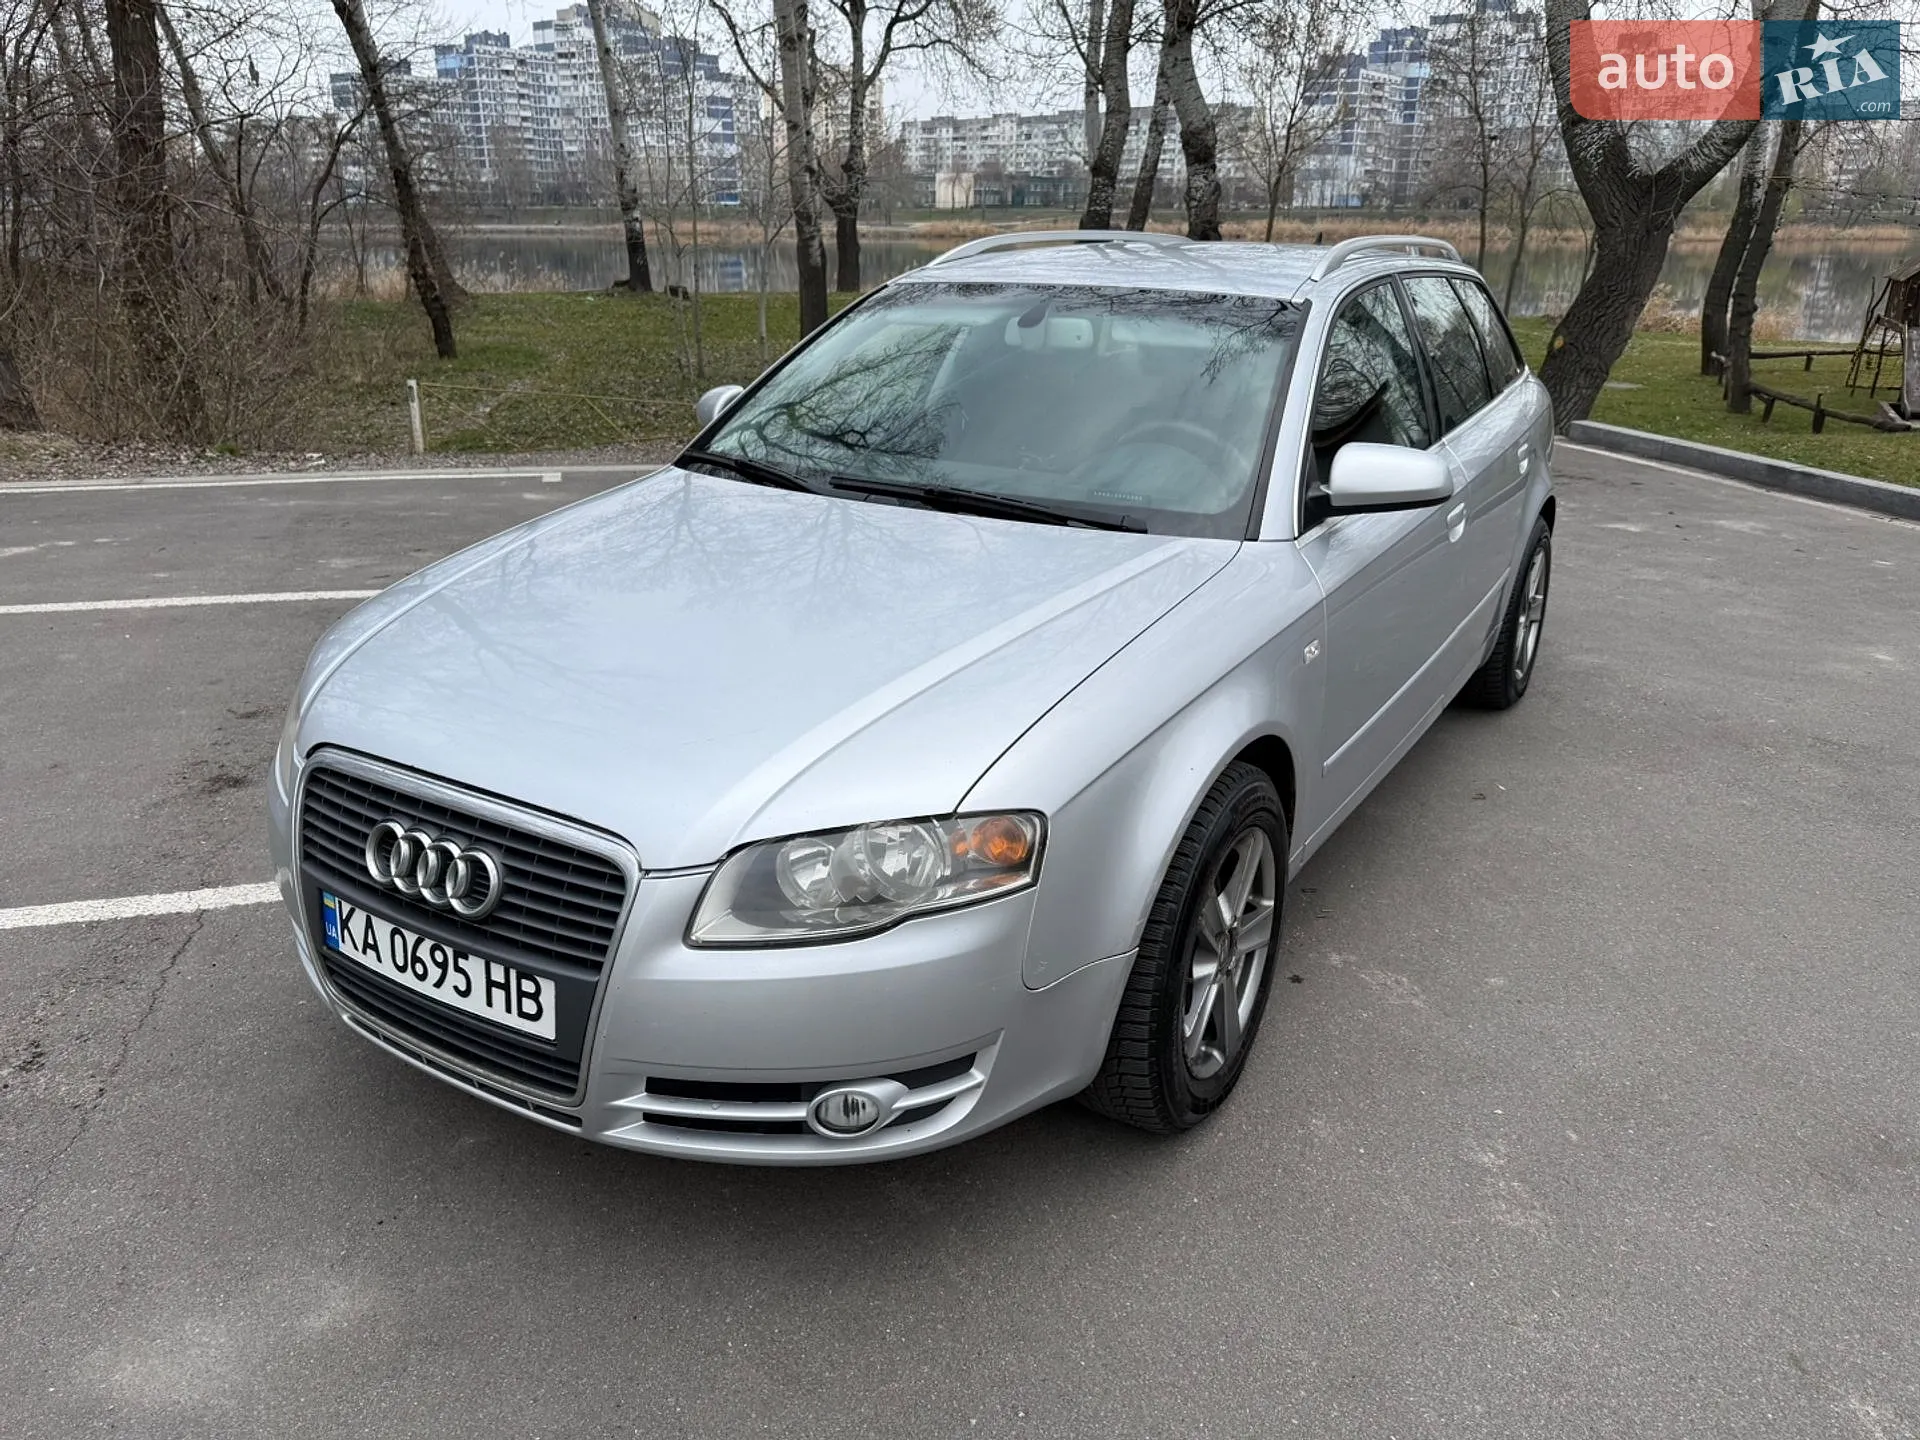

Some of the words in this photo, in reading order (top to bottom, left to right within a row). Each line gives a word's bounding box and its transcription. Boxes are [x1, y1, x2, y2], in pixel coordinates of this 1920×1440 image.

[325, 923, 338, 939] UA
[338, 900, 382, 963] KA
[390, 927, 472, 998] 0695
[485, 959, 543, 1022] HB
